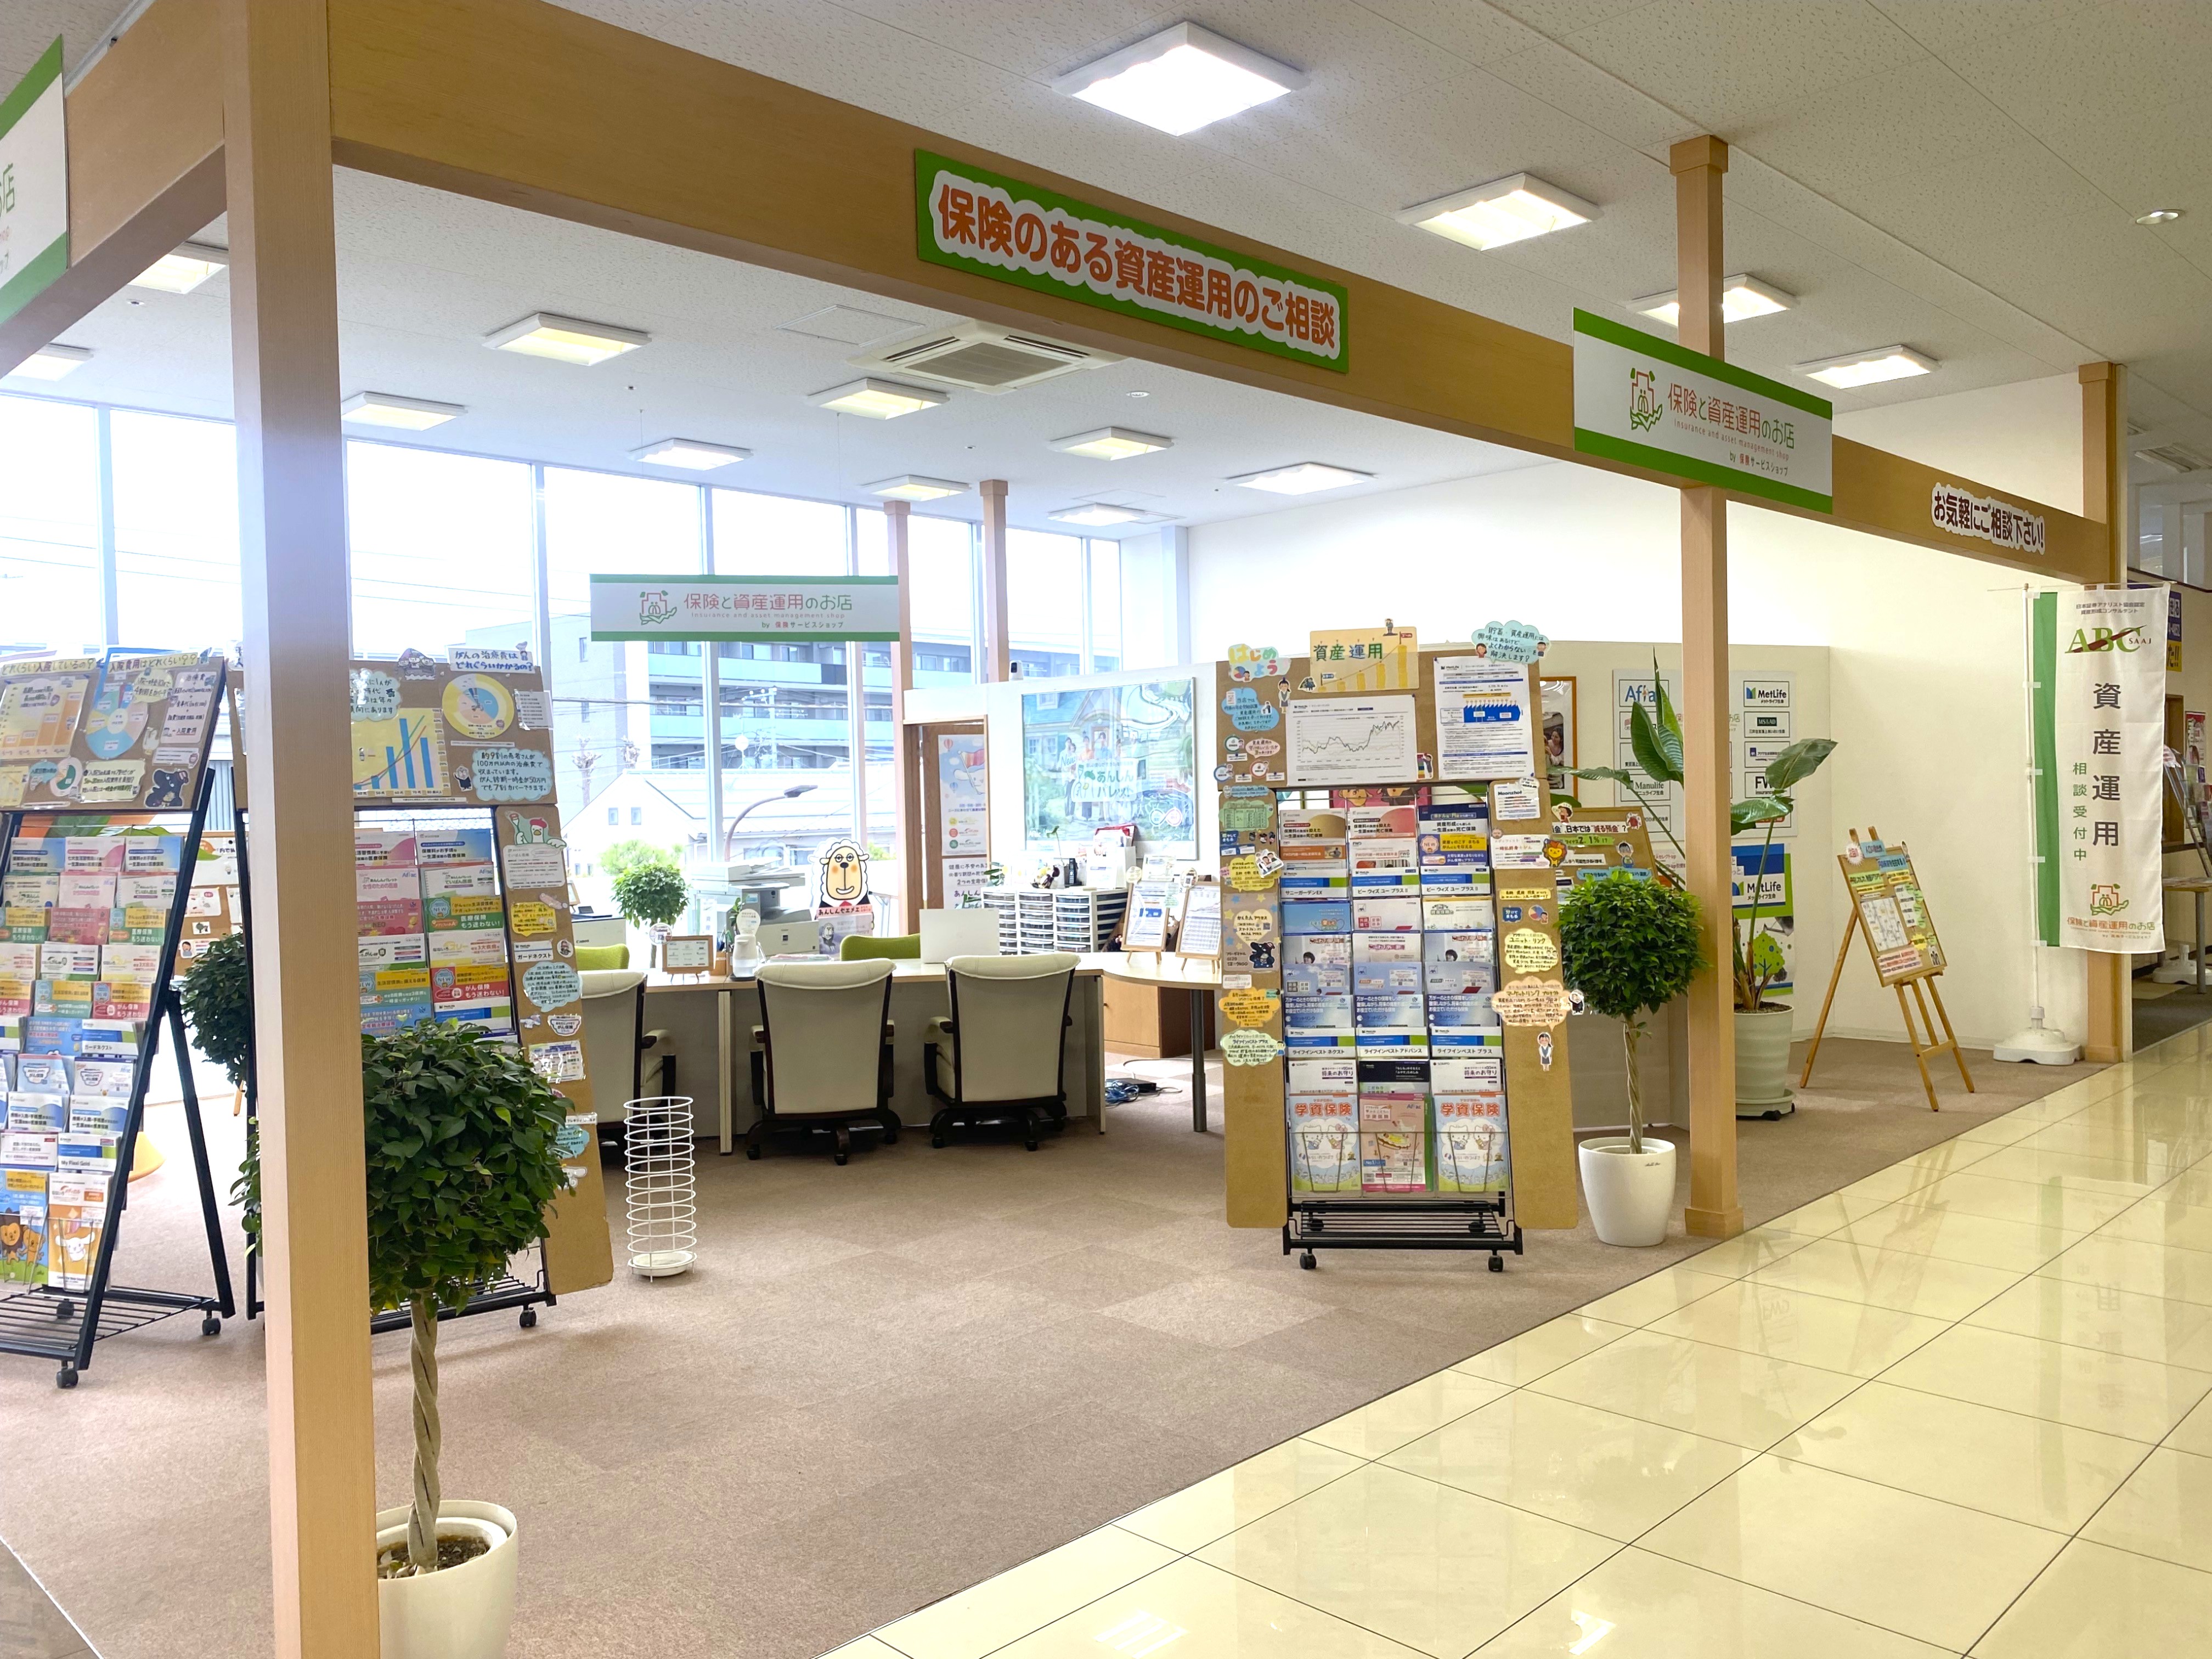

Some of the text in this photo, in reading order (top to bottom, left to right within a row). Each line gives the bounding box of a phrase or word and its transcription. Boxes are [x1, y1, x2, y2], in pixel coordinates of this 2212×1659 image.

[0, 162, 15, 218] 店
[938, 184, 1335, 349] 保険のある資産運用のご相談
[1668, 382, 1795, 450] 保険と資産運用のお店
[1708, 428, 1719, 439] and
[1722, 435, 1737, 445] asset
[1739, 439, 1775, 456] management
[1776, 449, 1790, 461] shop
[1729, 450, 1789, 476] by 保険サービスショップ
[1934, 491, 2044, 548] お気軽にご相談下さい!
[684, 593, 853, 611] 保険と資産運用のお店
[1477, 633, 1520, 646] 興味はあるけど
[2064, 627, 2141, 653] ABC
[455, 651, 518, 660] がんの治療費は
[1229, 645, 1278, 664] はじめ
[1313, 642, 1383, 662] 資産運用
[1488, 644, 1526, 653] よくわからない
[456, 661, 533, 671] どれぐらいかかるの?
[1254, 660, 1278, 676] よう
[1625, 685, 1656, 702] Afla
[1758, 689, 1787, 698] MetLife
[2091, 682, 2122, 847] 資産運用
[1097, 770, 1133, 783] あんしん
[2072, 761, 2087, 861] 相談受付中
[1747, 881, 1781, 893] MtLife
[2067, 916, 2155, 930] 保険と資産運用のお店
[465, 989, 505, 997] もう迷わない!
[1295, 1103, 1352, 1116] 学資保険
[1441, 1103, 1500, 1116] 学資保険
